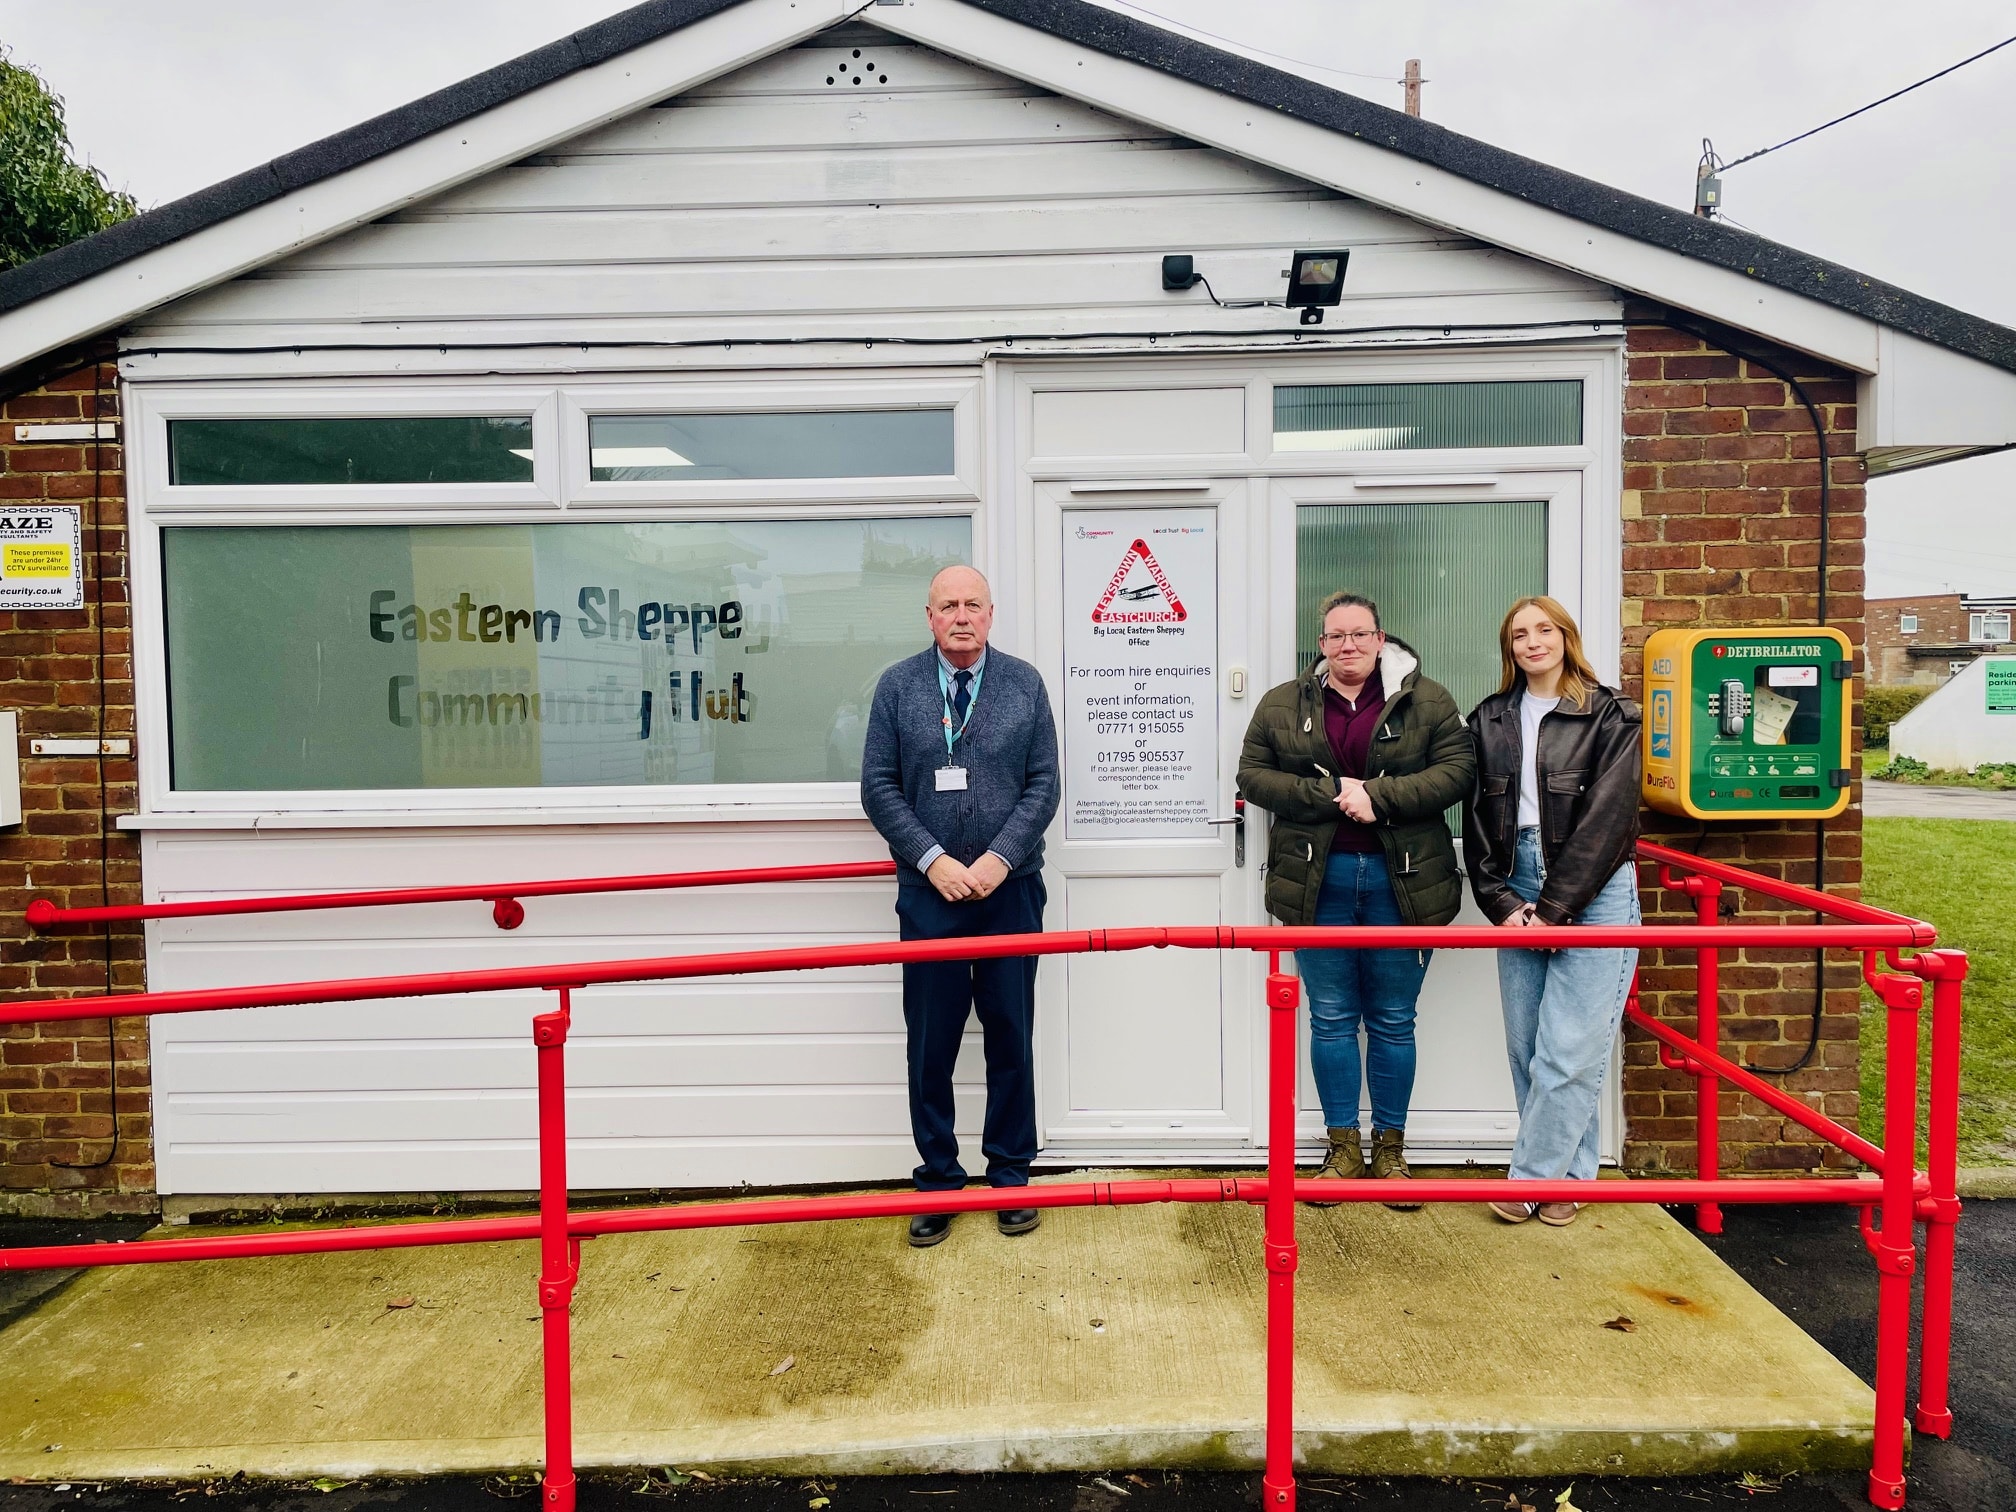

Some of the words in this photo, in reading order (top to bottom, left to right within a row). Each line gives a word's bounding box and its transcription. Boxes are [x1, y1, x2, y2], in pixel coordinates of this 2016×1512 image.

[1096, 549, 1139, 613] LEYSDOWN
[1143, 553, 1179, 605] WARDEN
[0, 588, 62, 596] ecurity.co.uk
[369, 590, 562, 643] Eastern
[578, 586, 771, 655] Sheppey
[1100, 611, 1179, 623] EASTCHURCH
[1093, 626, 1105, 637] Big
[1106, 627, 1126, 635] Local
[1127, 625, 1155, 635] Eastern
[1156, 625, 1185, 636] Sheppey
[1128, 638, 1150, 646] Office
[1727, 645, 1822, 658] DEFIBRILLATOR
[1070, 666, 1091, 678] For
[1094, 668, 1125, 677] room
[1129, 665, 1152, 676] hire
[1155, 664, 1211, 678] enquiries
[1652, 659, 1672, 675] AED
[1134, 682, 1147, 691] or
[1086, 695, 1120, 706] event
[1123, 693, 1195, 705] information,
[1088, 709, 1128, 722] please
[1131, 708, 1176, 720] contact
[1179, 710, 1194, 719] us
[1097, 723, 1134, 735] 07771
[1138, 722, 1185, 734] 915055
[1134, 739, 1147, 748] or
[1097, 751, 1136, 763] 01795
[1139, 750, 1185, 762] 905537
[1142, 764, 1169, 775] please
[1170, 764, 1193, 772] leave
[1097, 774, 1161, 783] correspondence
[1163, 773, 1171, 781] in
[1172, 772, 1185, 781] the
[1121, 783, 1142, 791] letter
